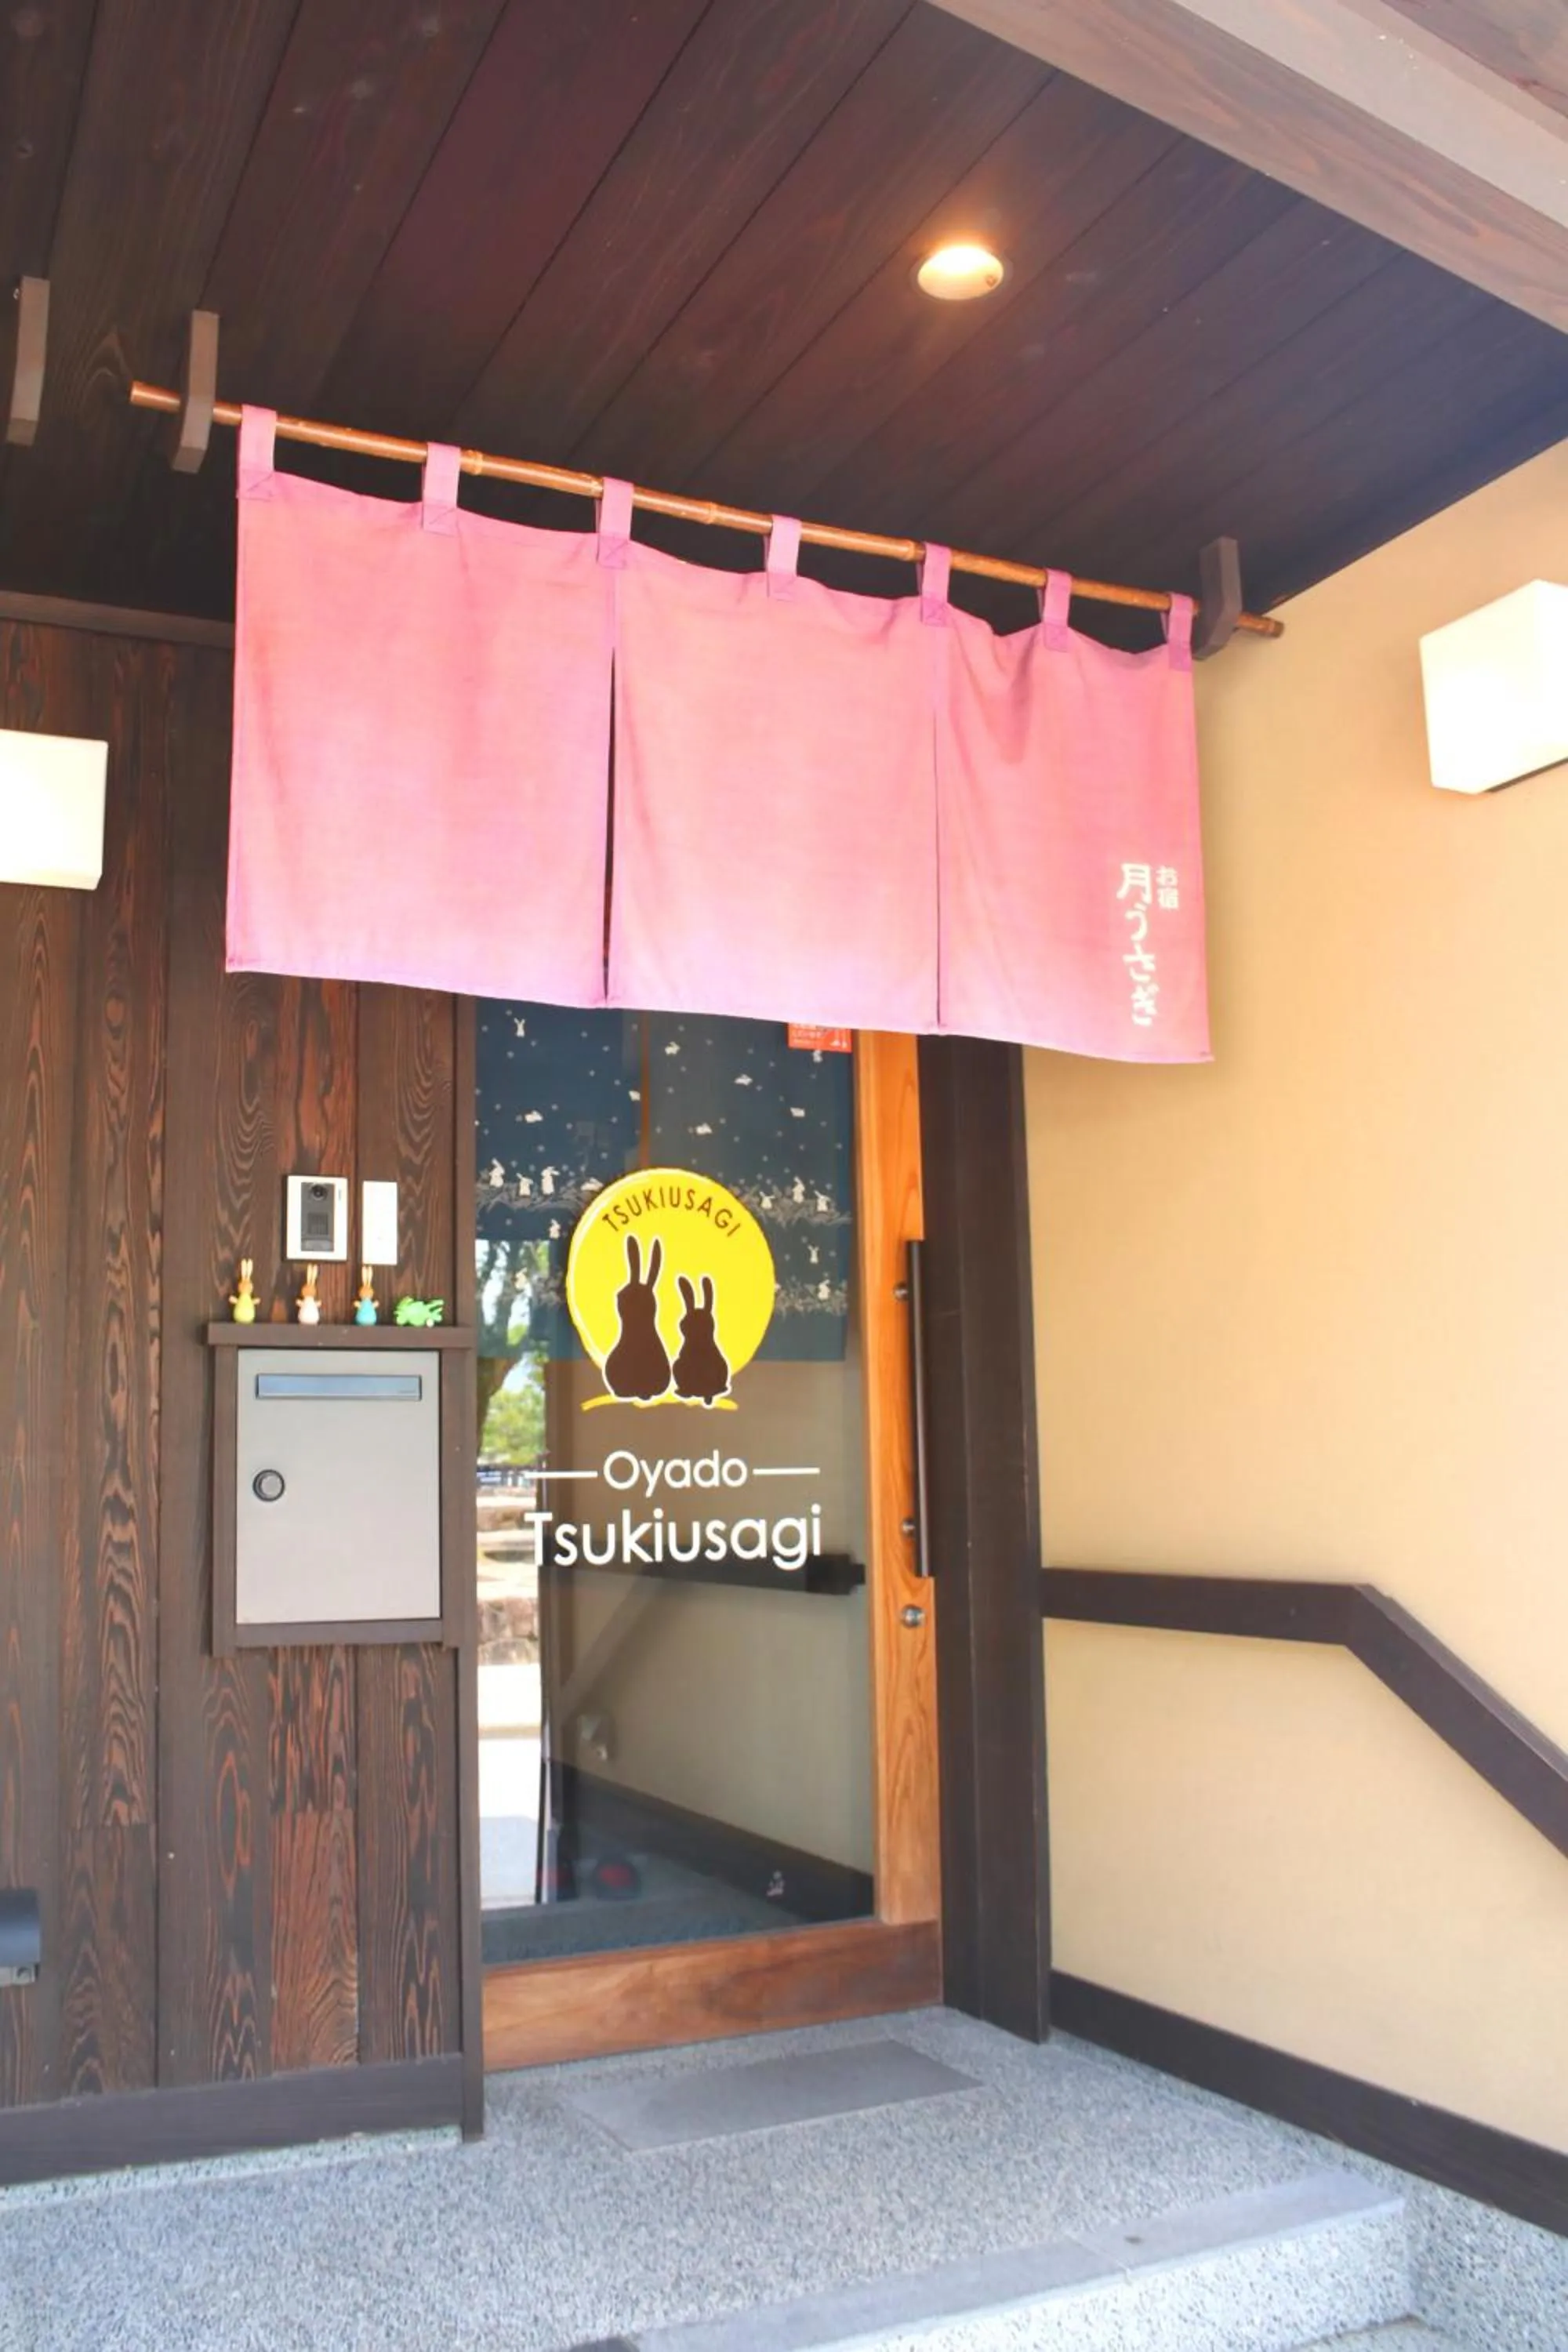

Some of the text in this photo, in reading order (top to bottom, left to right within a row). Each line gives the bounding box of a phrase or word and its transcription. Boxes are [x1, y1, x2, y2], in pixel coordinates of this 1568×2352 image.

[1116, 862, 1160, 1026] 月うさぎ
[601, 1185, 741, 1238] TSUKIUSAGI
[604, 1450, 748, 1497] Oyado
[524, 1504, 822, 1570] Tsukiusagi
